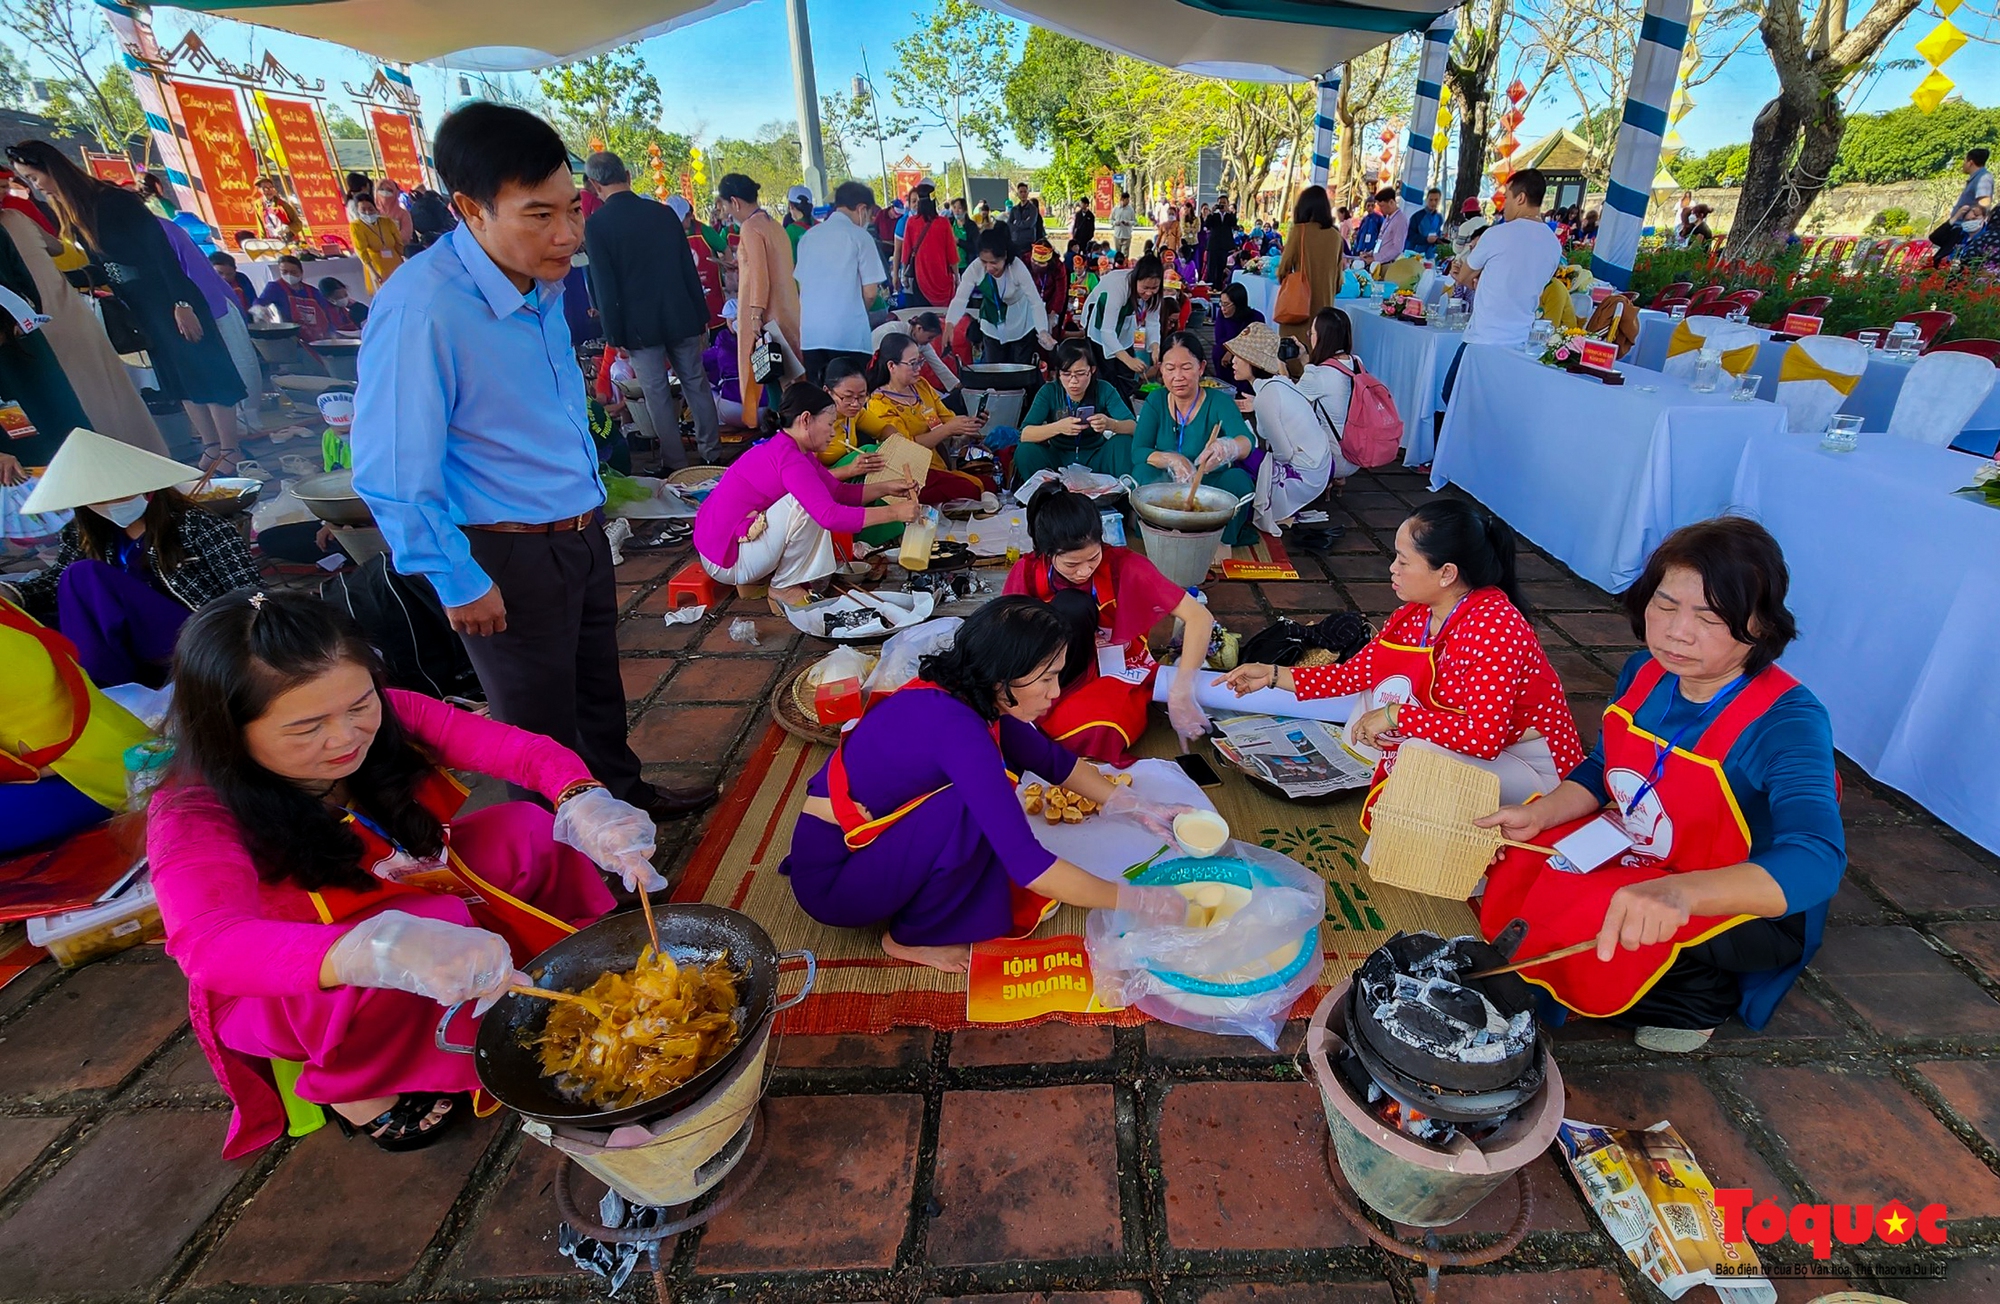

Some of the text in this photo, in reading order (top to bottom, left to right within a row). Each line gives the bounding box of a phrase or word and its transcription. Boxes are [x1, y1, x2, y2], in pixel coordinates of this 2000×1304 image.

[1003, 951, 1083, 978] PHÚ HỘI
[1002, 974, 1087, 1000] PHƯỜNG
